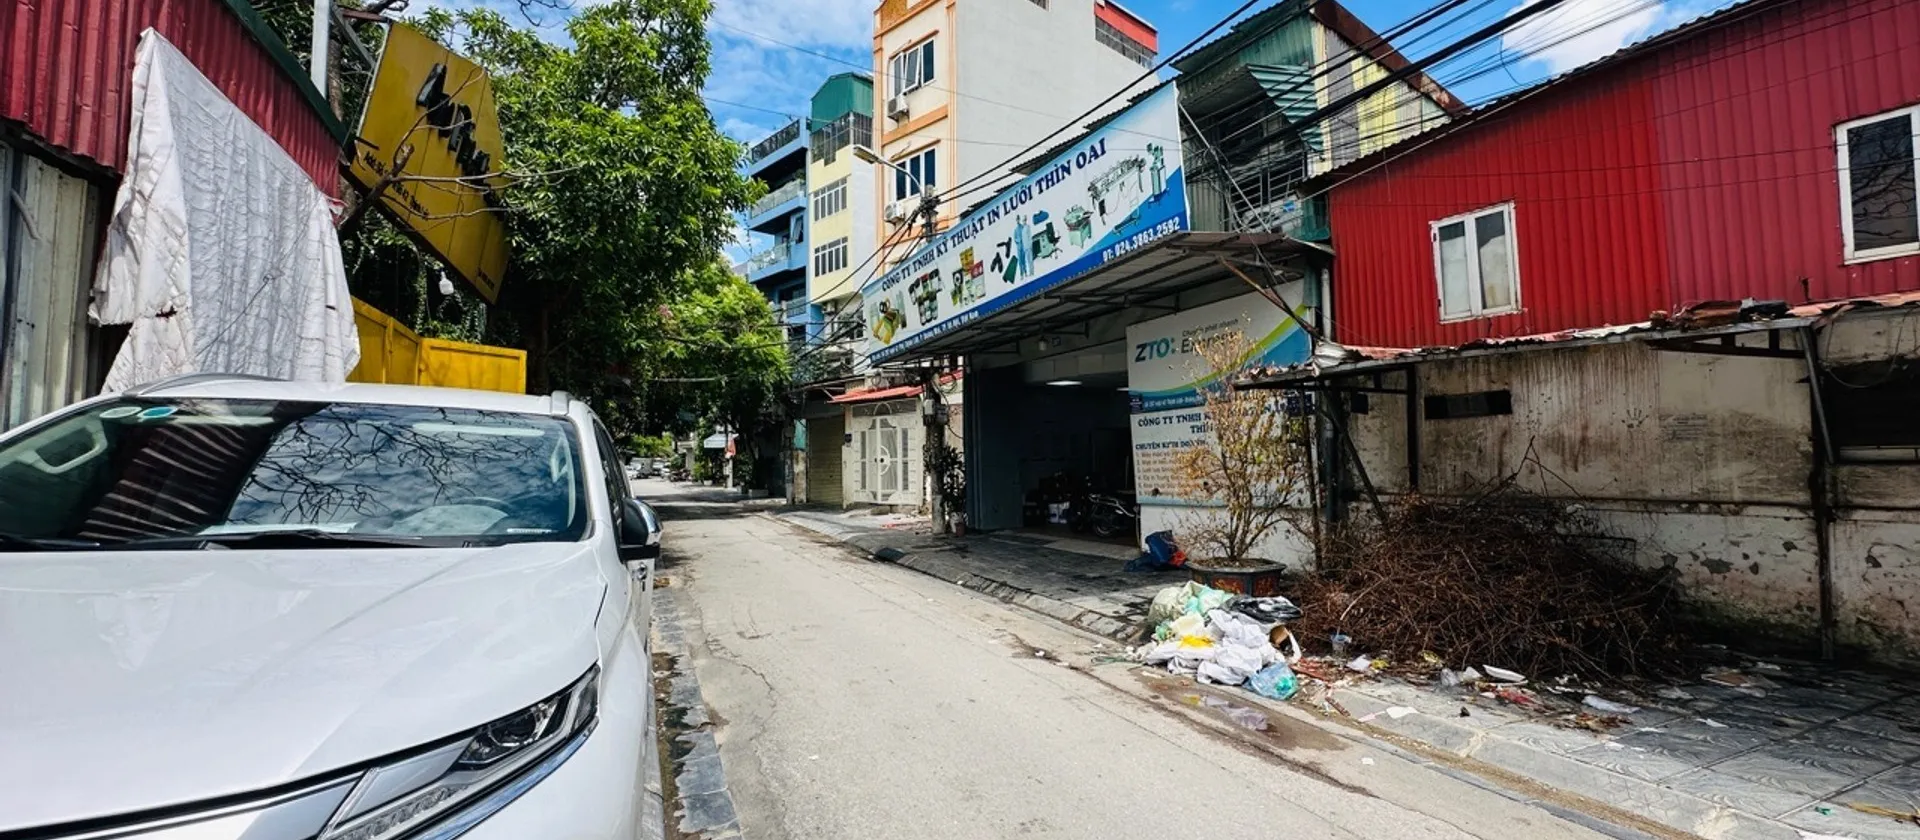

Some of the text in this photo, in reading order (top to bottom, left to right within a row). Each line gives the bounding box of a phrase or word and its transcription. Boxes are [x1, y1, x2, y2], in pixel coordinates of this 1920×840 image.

[901, 264, 911, 280] TY
[912, 248, 936, 272] TNHH
[950, 215, 985, 248] THUẬT
[986, 205, 1001, 227] IN
[1034, 159, 1072, 195] THÌN
[1075, 137, 1107, 170] OAI
[1137, 416, 1160, 427] CÔNG
[1161, 415, 1174, 424] TY
[1175, 412, 1201, 423] TNHH
